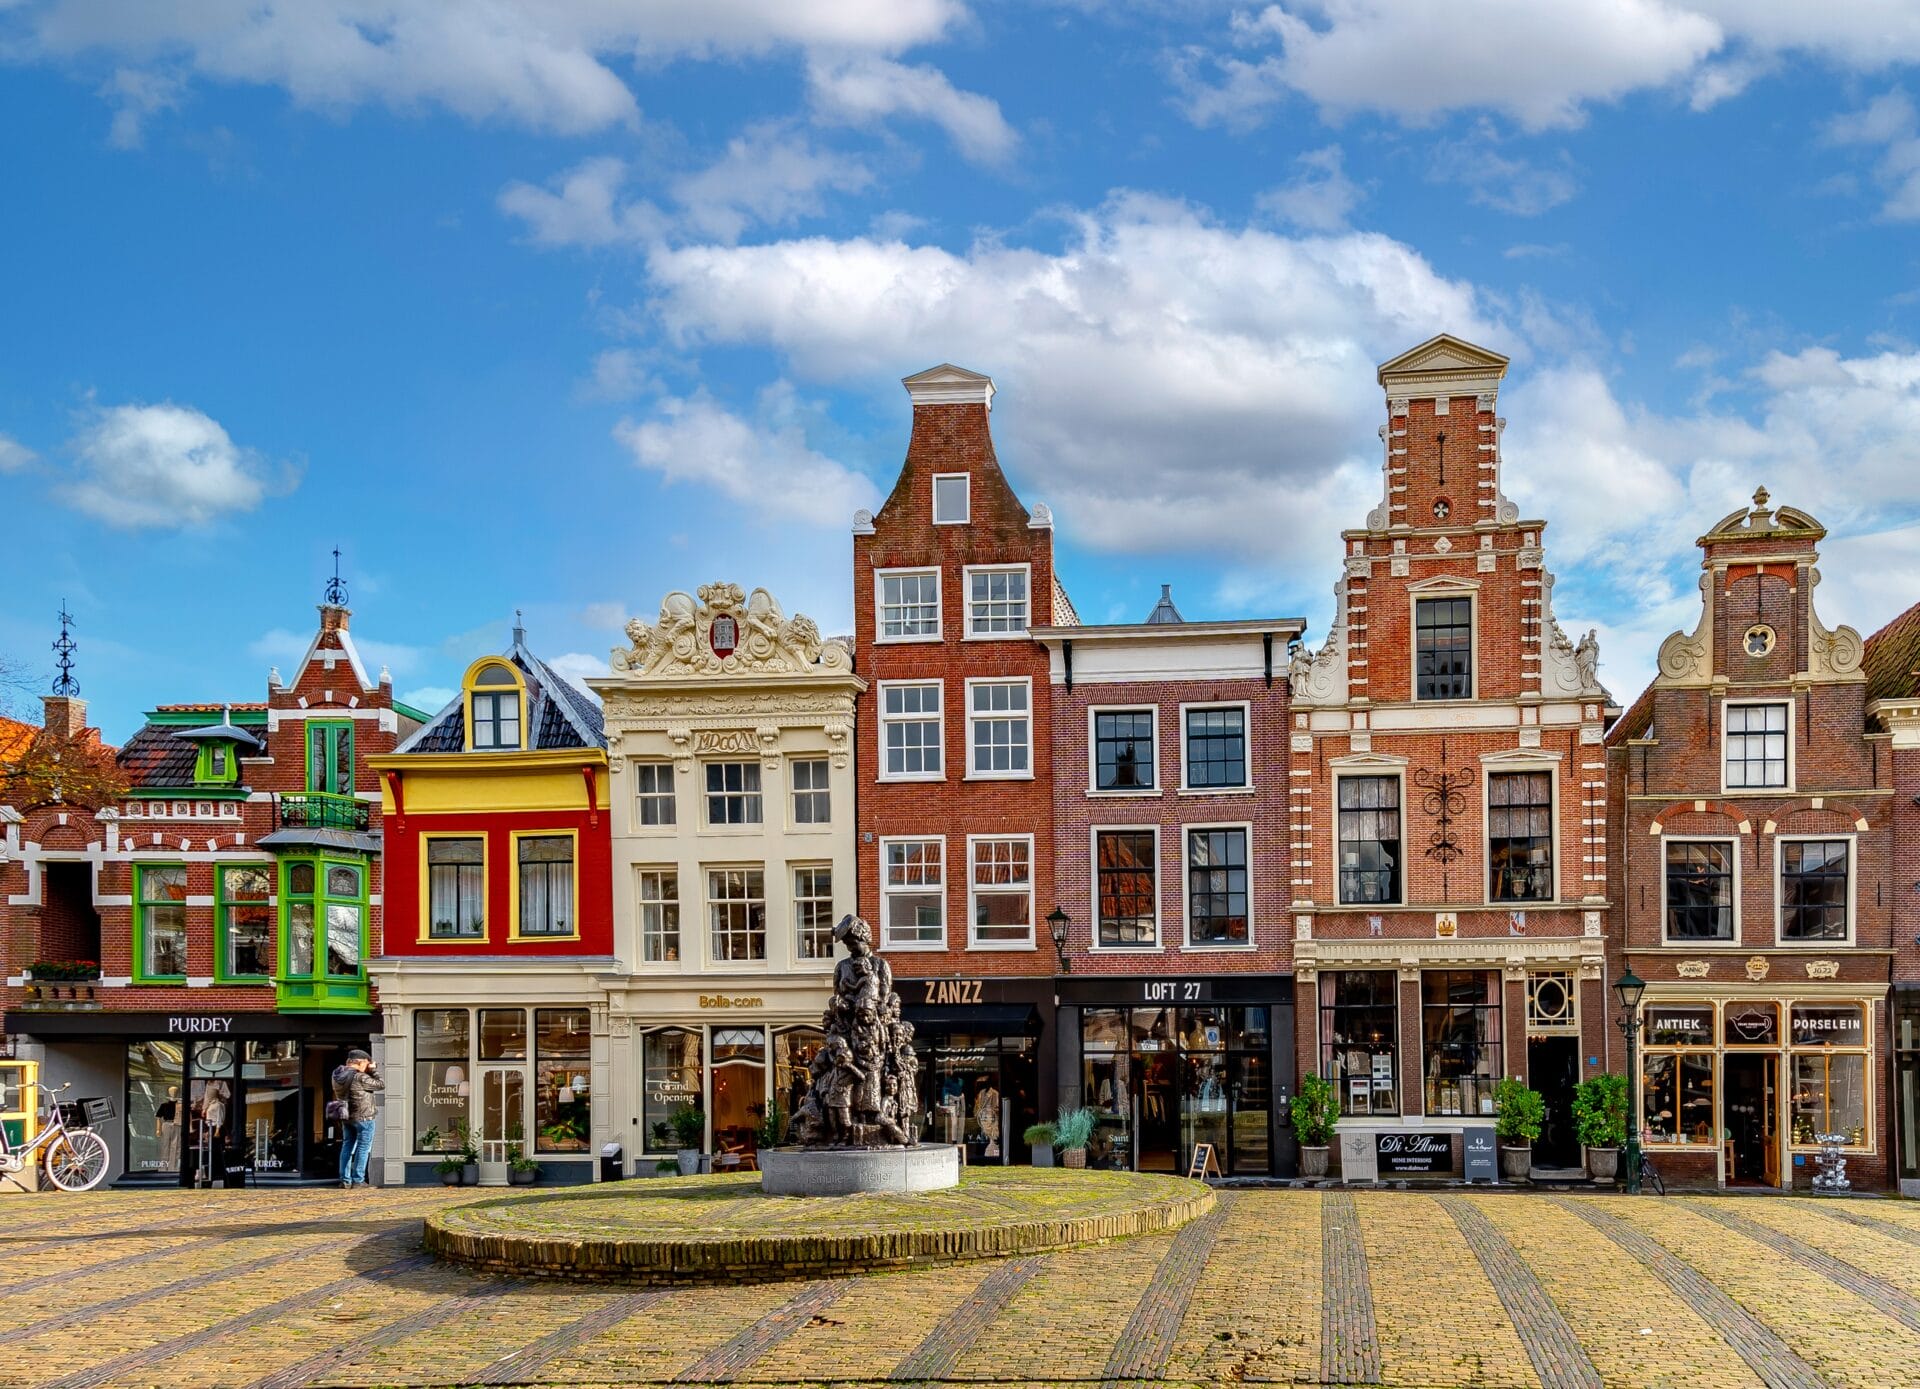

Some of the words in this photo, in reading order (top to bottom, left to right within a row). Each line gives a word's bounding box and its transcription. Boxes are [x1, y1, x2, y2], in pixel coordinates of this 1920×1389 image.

[925, 981, 983, 1004] ZANZZ
[1144, 982, 1177, 1000] LOFT
[1184, 982, 1201, 1000] 27
[169, 1017, 233, 1032] PURDEY
[1656, 1019, 1700, 1030] ANTIEK
[1793, 1019, 1860, 1030] PORSELEIN
[429, 1083, 459, 1093] Grand
[660, 1079, 689, 1091] Grand
[423, 1094, 465, 1107] Opening
[654, 1092, 695, 1105] Opening
[1379, 1135, 1406, 1153] Di
[1404, 1135, 1448, 1153] Alma
[141, 1160, 170, 1168] PURDEY
[254, 1160, 283, 1168] PURDEY
